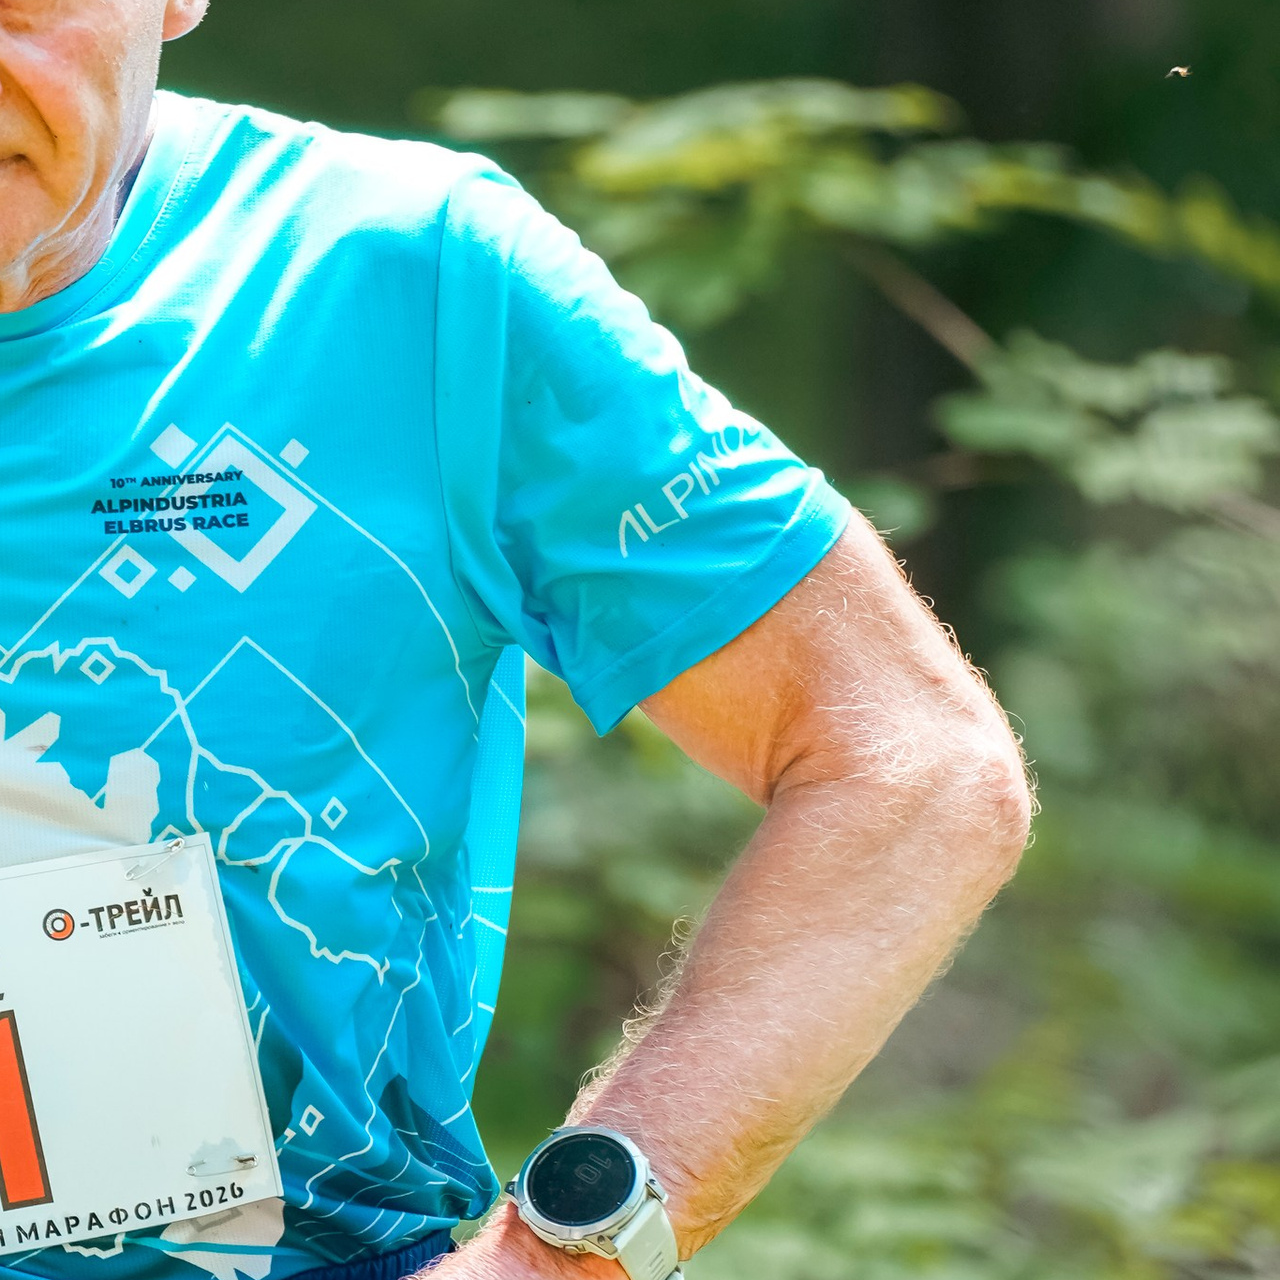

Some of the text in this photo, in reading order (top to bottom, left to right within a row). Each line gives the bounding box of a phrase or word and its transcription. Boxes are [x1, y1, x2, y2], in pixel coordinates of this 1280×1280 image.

[140, 470, 243, 487] ANNIVERSARY
[91, 492, 248, 514] ALPINDUSTRIA
[104, 513, 250, 534] ELBRUS RACE
[16, 1196, 176, 1244] МАРАФОН
[184, 1182, 244, 1211] 2026
